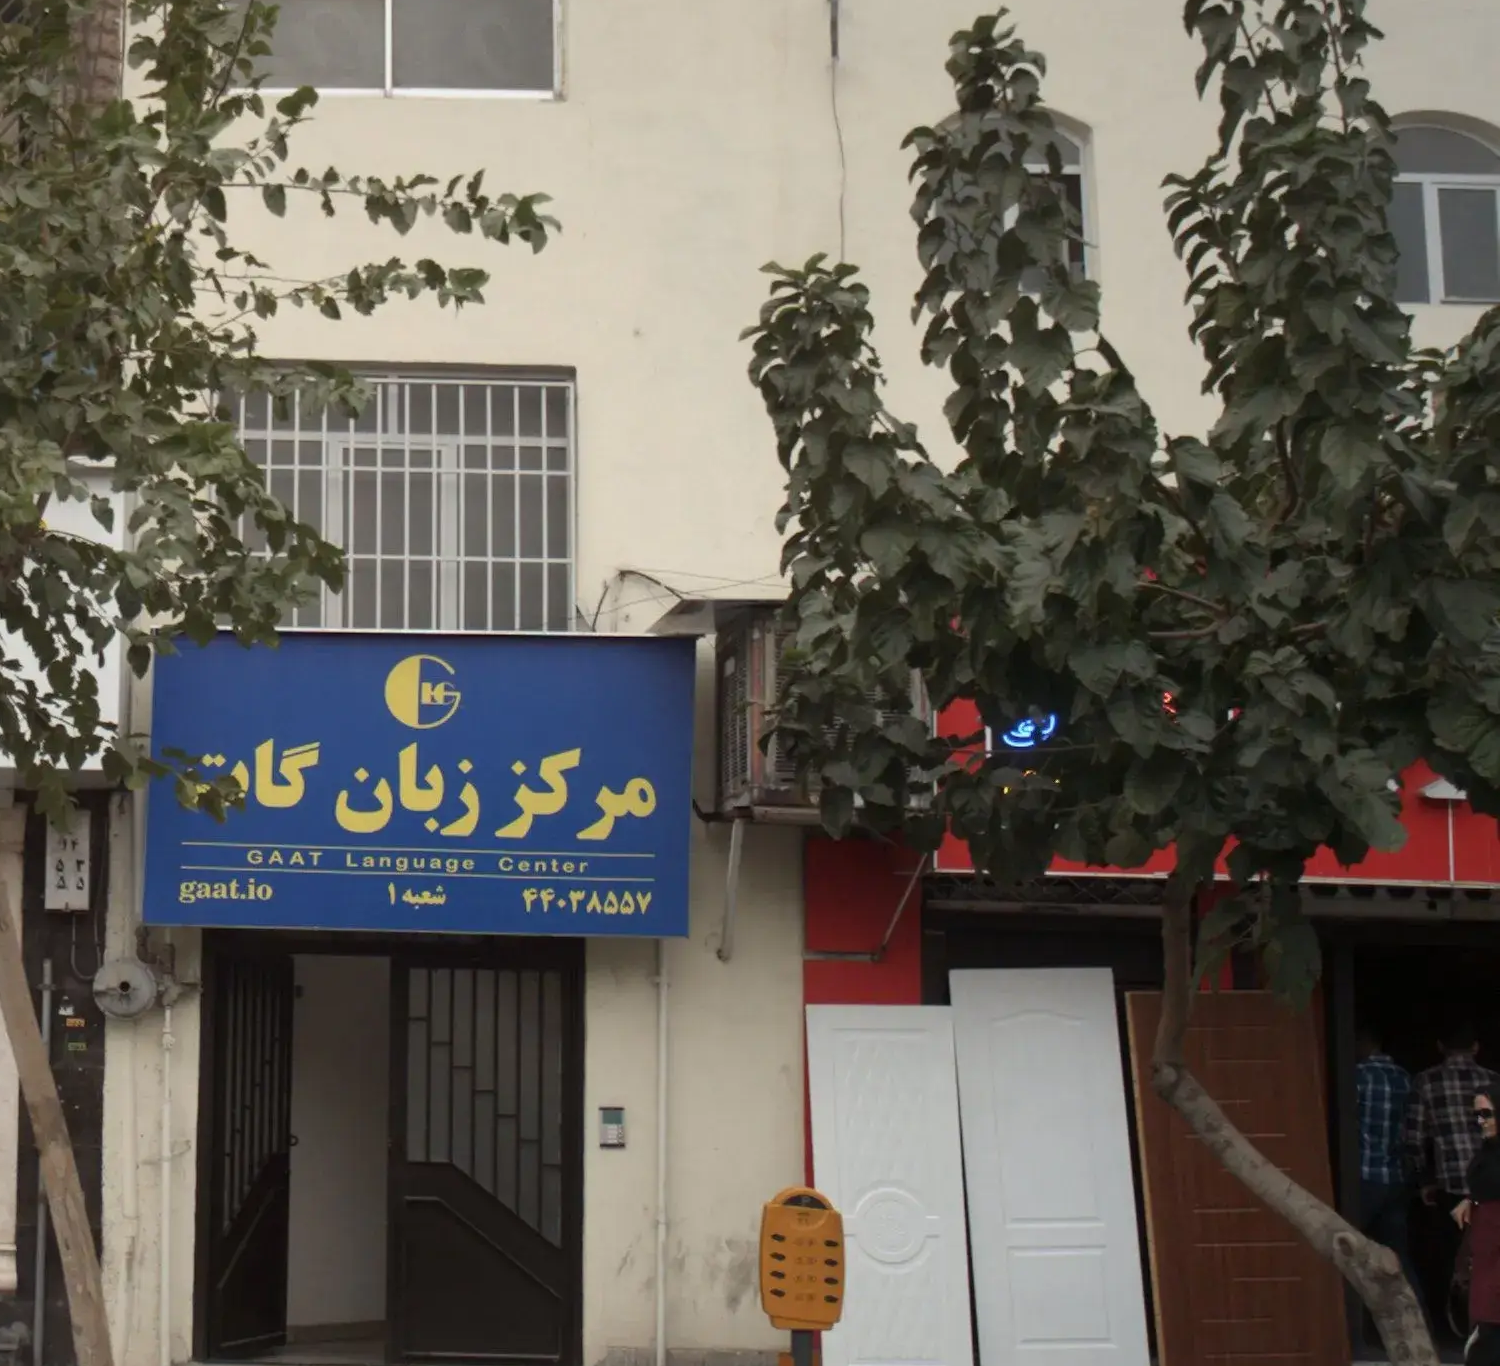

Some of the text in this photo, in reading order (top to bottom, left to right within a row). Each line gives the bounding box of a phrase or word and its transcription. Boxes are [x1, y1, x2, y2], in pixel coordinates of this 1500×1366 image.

[335, 741, 481, 837] زبان
[495, 747, 657, 840] مرکز
[247, 850, 590, 874] GAAT Language Center
[179, 878, 274, 904] gaat.io
[402, 884, 447, 908] شعبه
[522, 887, 653, 916] ۴۴۰۳۸۵۵۷
